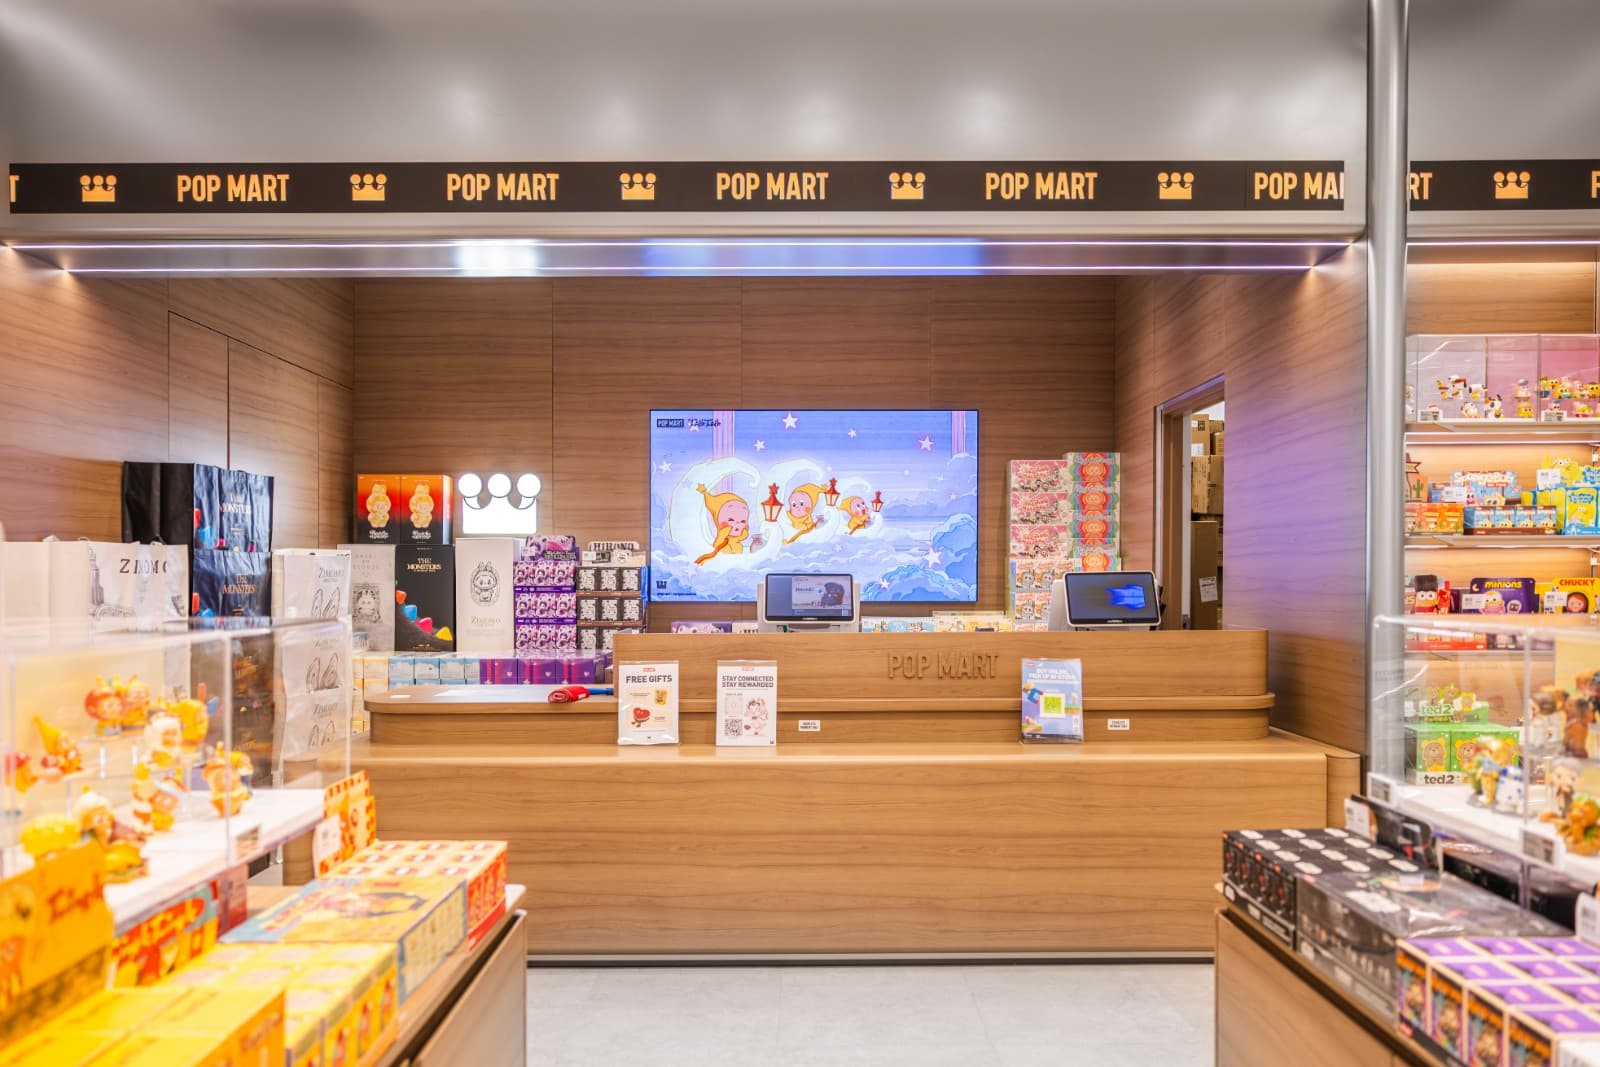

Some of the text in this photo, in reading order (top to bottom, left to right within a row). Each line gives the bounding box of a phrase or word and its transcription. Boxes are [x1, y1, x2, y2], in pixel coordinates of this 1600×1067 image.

[177, 173, 290, 202] POP MART
[446, 172, 560, 201] POP MART
[716, 171, 829, 200] POP MART
[985, 171, 1098, 200] POP MART
[1254, 171, 1298, 200] POP
[625, 674, 673, 684] FREE GIFTS
[888, 652, 999, 679] POP MART
